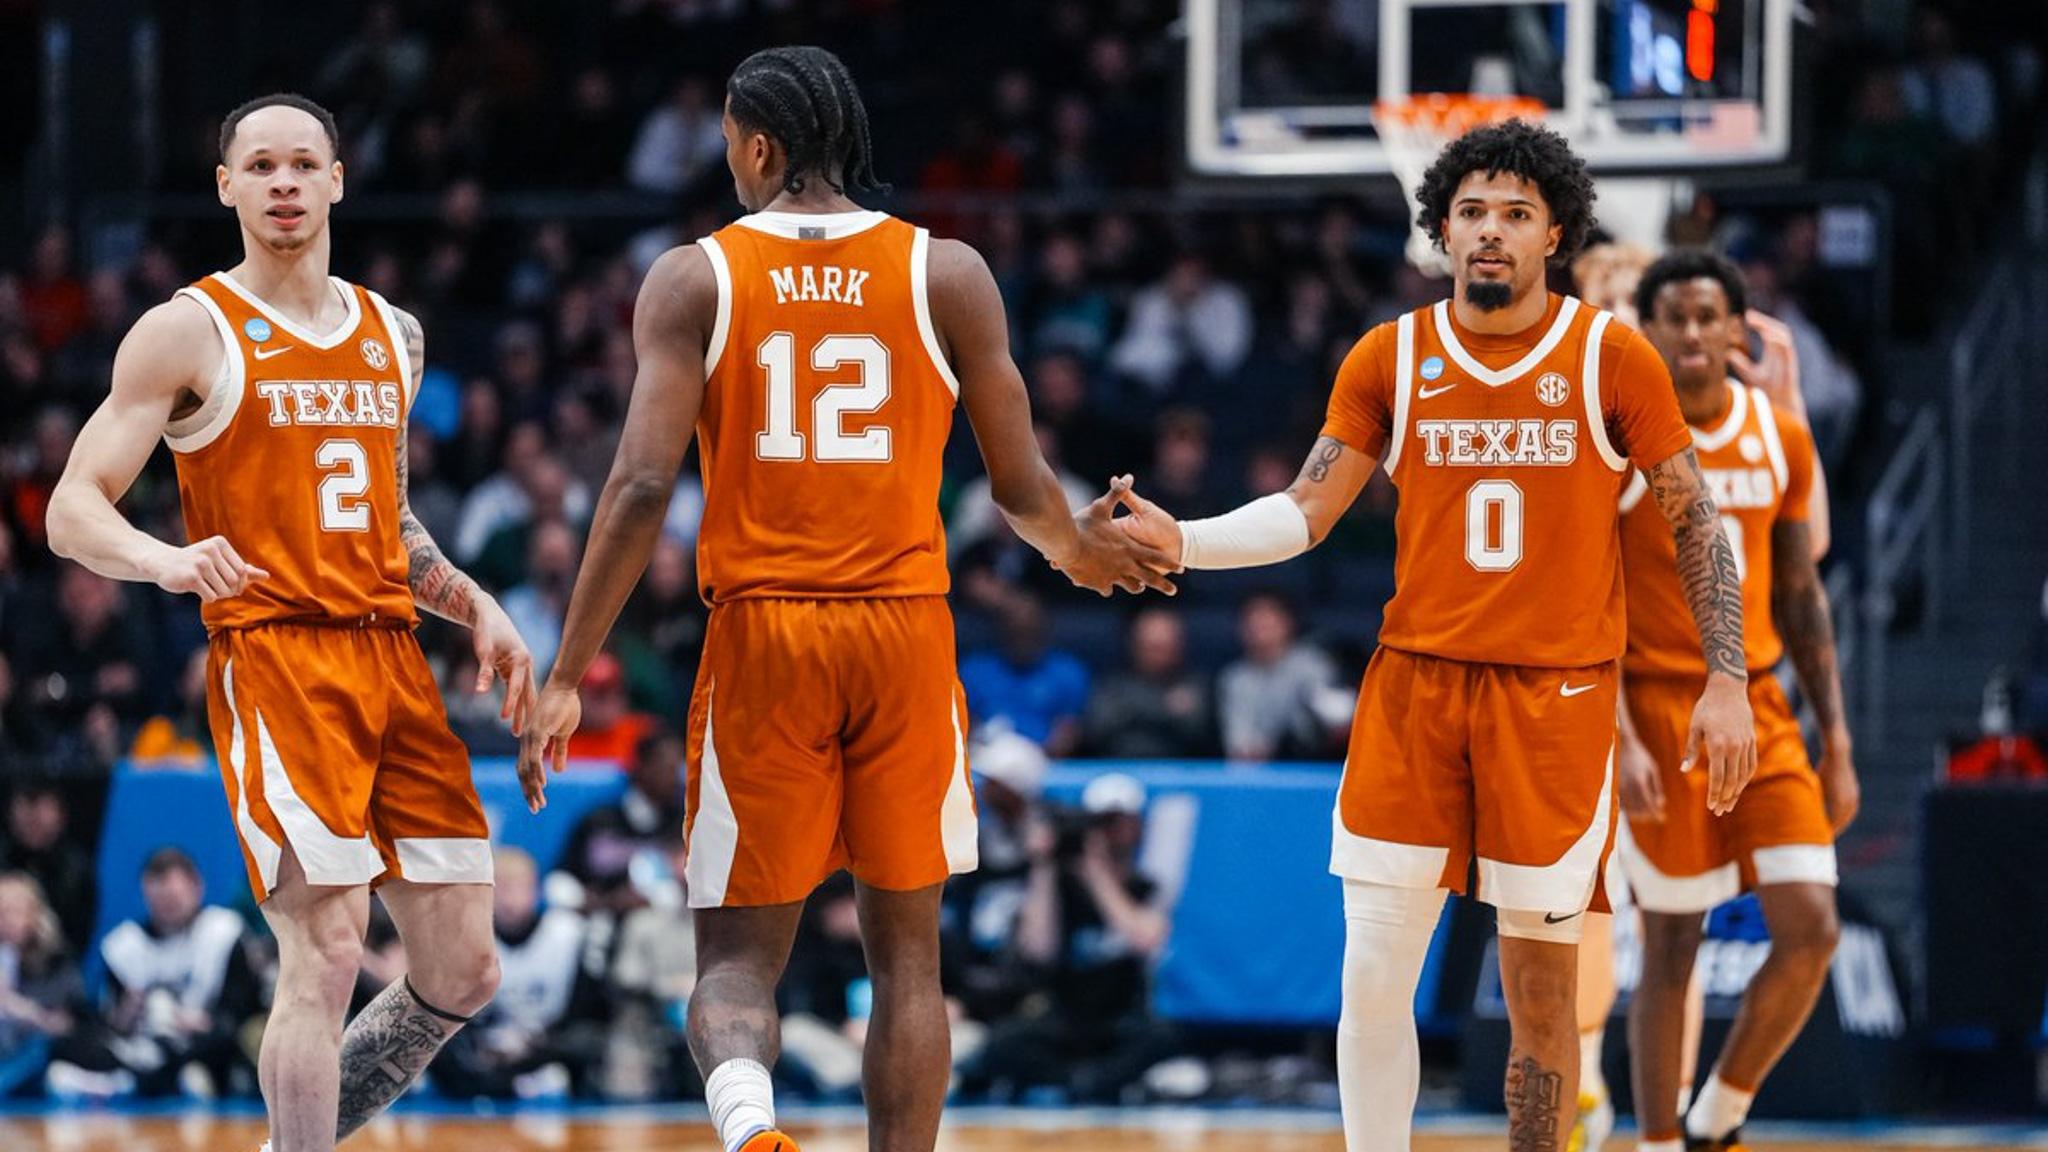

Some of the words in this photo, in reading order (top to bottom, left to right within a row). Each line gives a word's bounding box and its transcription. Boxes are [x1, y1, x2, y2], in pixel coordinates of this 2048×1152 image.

[769, 265, 870, 307] MARK
[361, 339, 388, 370] SEC
[256, 380, 400, 429] TEXAS
[756, 331, 892, 463] 12
[1536, 373, 1570, 406] SEC
[1416, 419, 1577, 466] TEXAS
[315, 438, 371, 533] 2
[1464, 479, 1525, 573] 0
